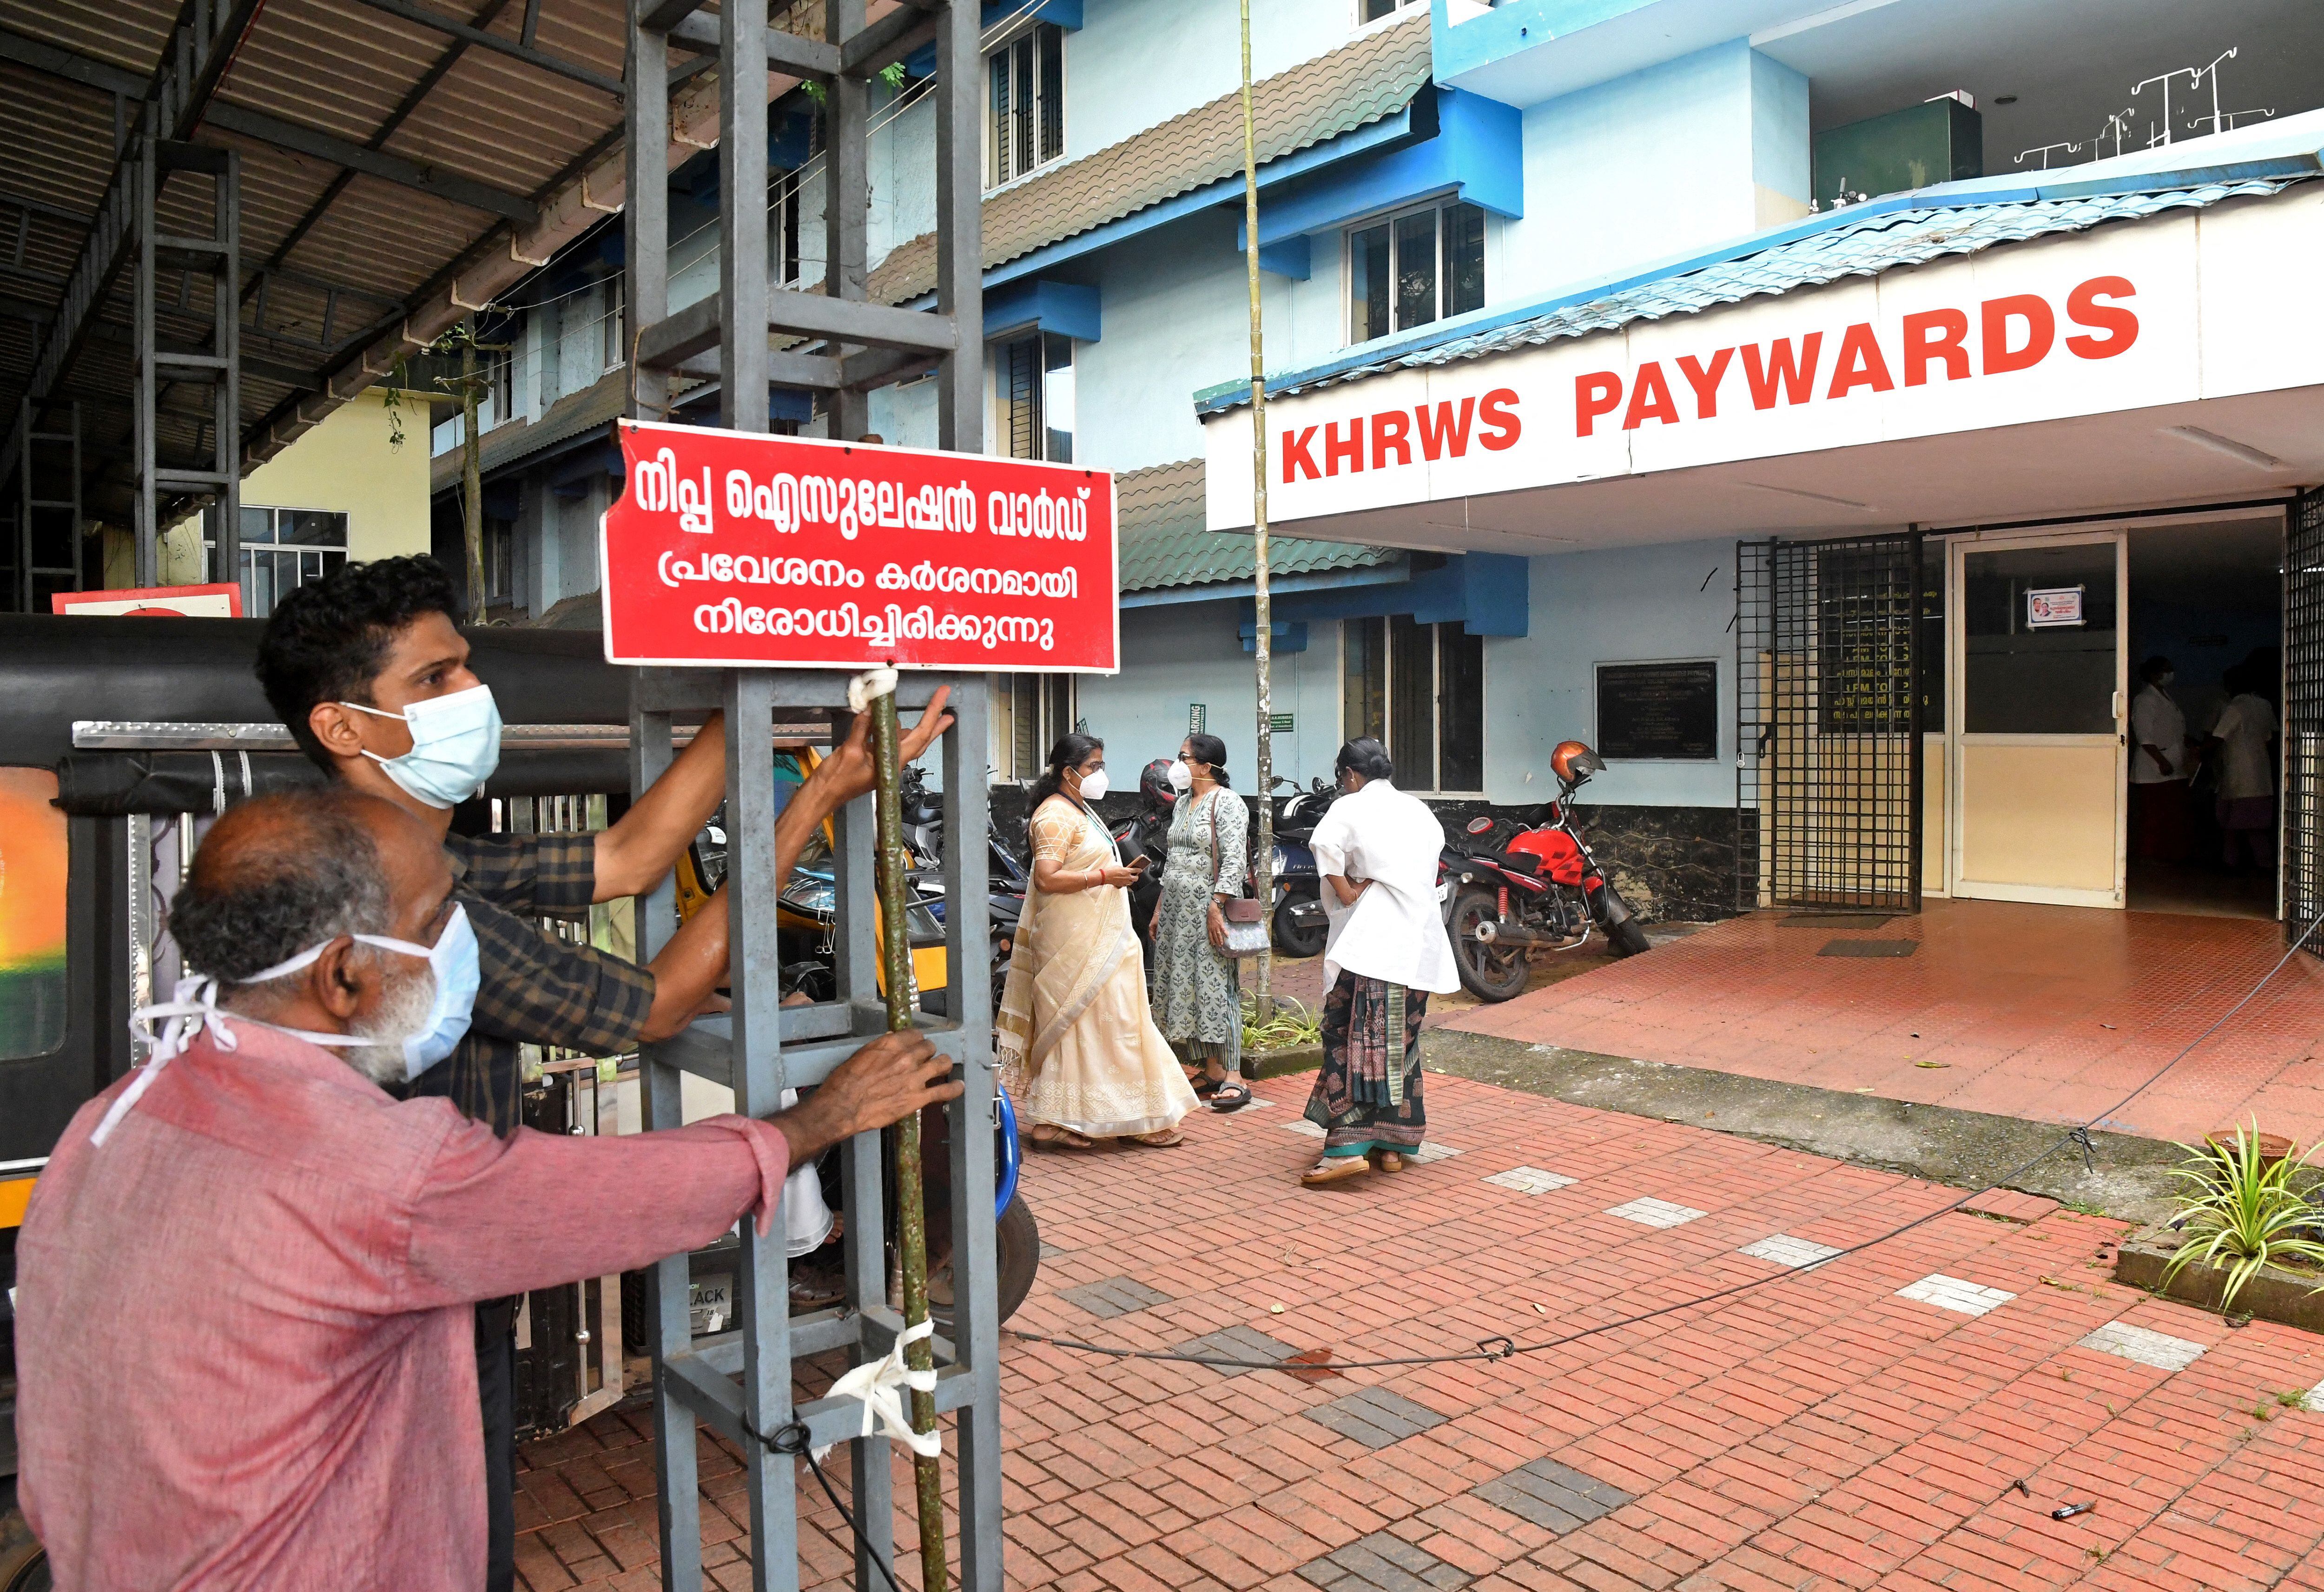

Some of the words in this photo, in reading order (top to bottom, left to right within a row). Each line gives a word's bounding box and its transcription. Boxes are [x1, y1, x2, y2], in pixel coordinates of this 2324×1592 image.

[1282, 388, 1521, 484] KHRWS
[1575, 275, 2139, 438] PAYWARDS
[634, 446, 714, 534] നിപ്പ
[725, 469, 977, 541] ഐസുലേഷൻ
[988, 486, 1091, 542] വാർഡ്
[657, 550, 865, 588] പ്രവേശനം
[875, 560, 1078, 599] കർശനമായി
[693, 596, 1055, 651] നിരോധിച്ചിരിക്കുന്നു
[1191, 706, 1200, 734] ARKING
